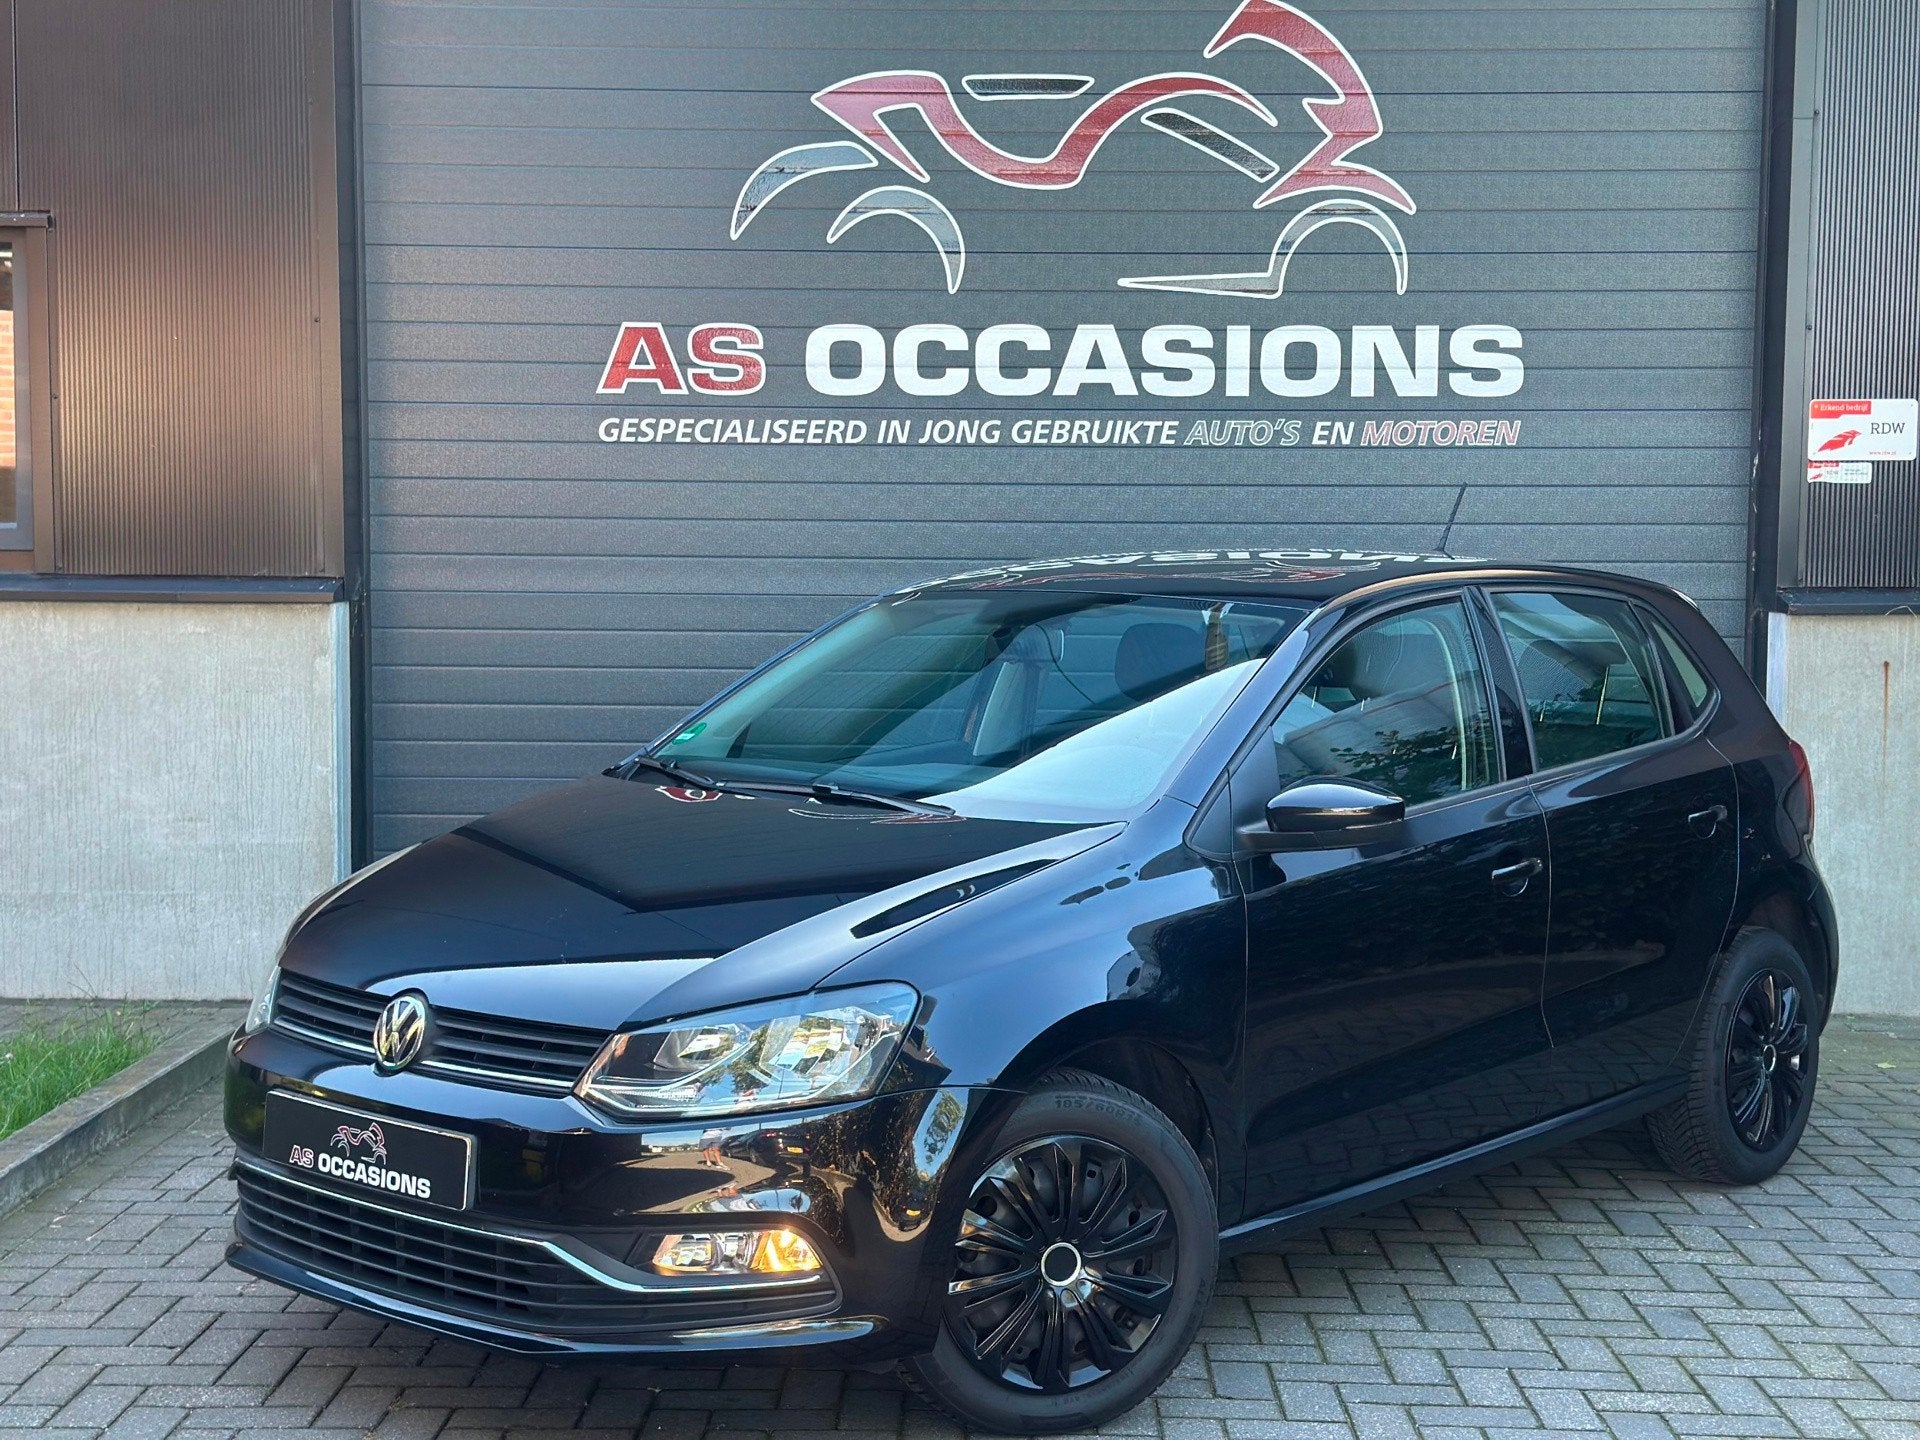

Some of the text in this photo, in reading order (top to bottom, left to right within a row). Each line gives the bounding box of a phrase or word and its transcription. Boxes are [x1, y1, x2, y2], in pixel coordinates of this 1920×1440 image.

[596, 321, 1525, 398] AS OCCASIONS
[598, 418, 867, 444] GESPECIALISEERD
[878, 420, 911, 444] IN
[918, 420, 1001, 444] JONG
[1010, 420, 1179, 446] GEBRUIKTE
[1312, 421, 1354, 446] EN
[1360, 421, 1521, 446] MOTOREN
[1870, 422, 1906, 435] RDW
[290, 1145, 431, 1198] AS OCCASIONS
